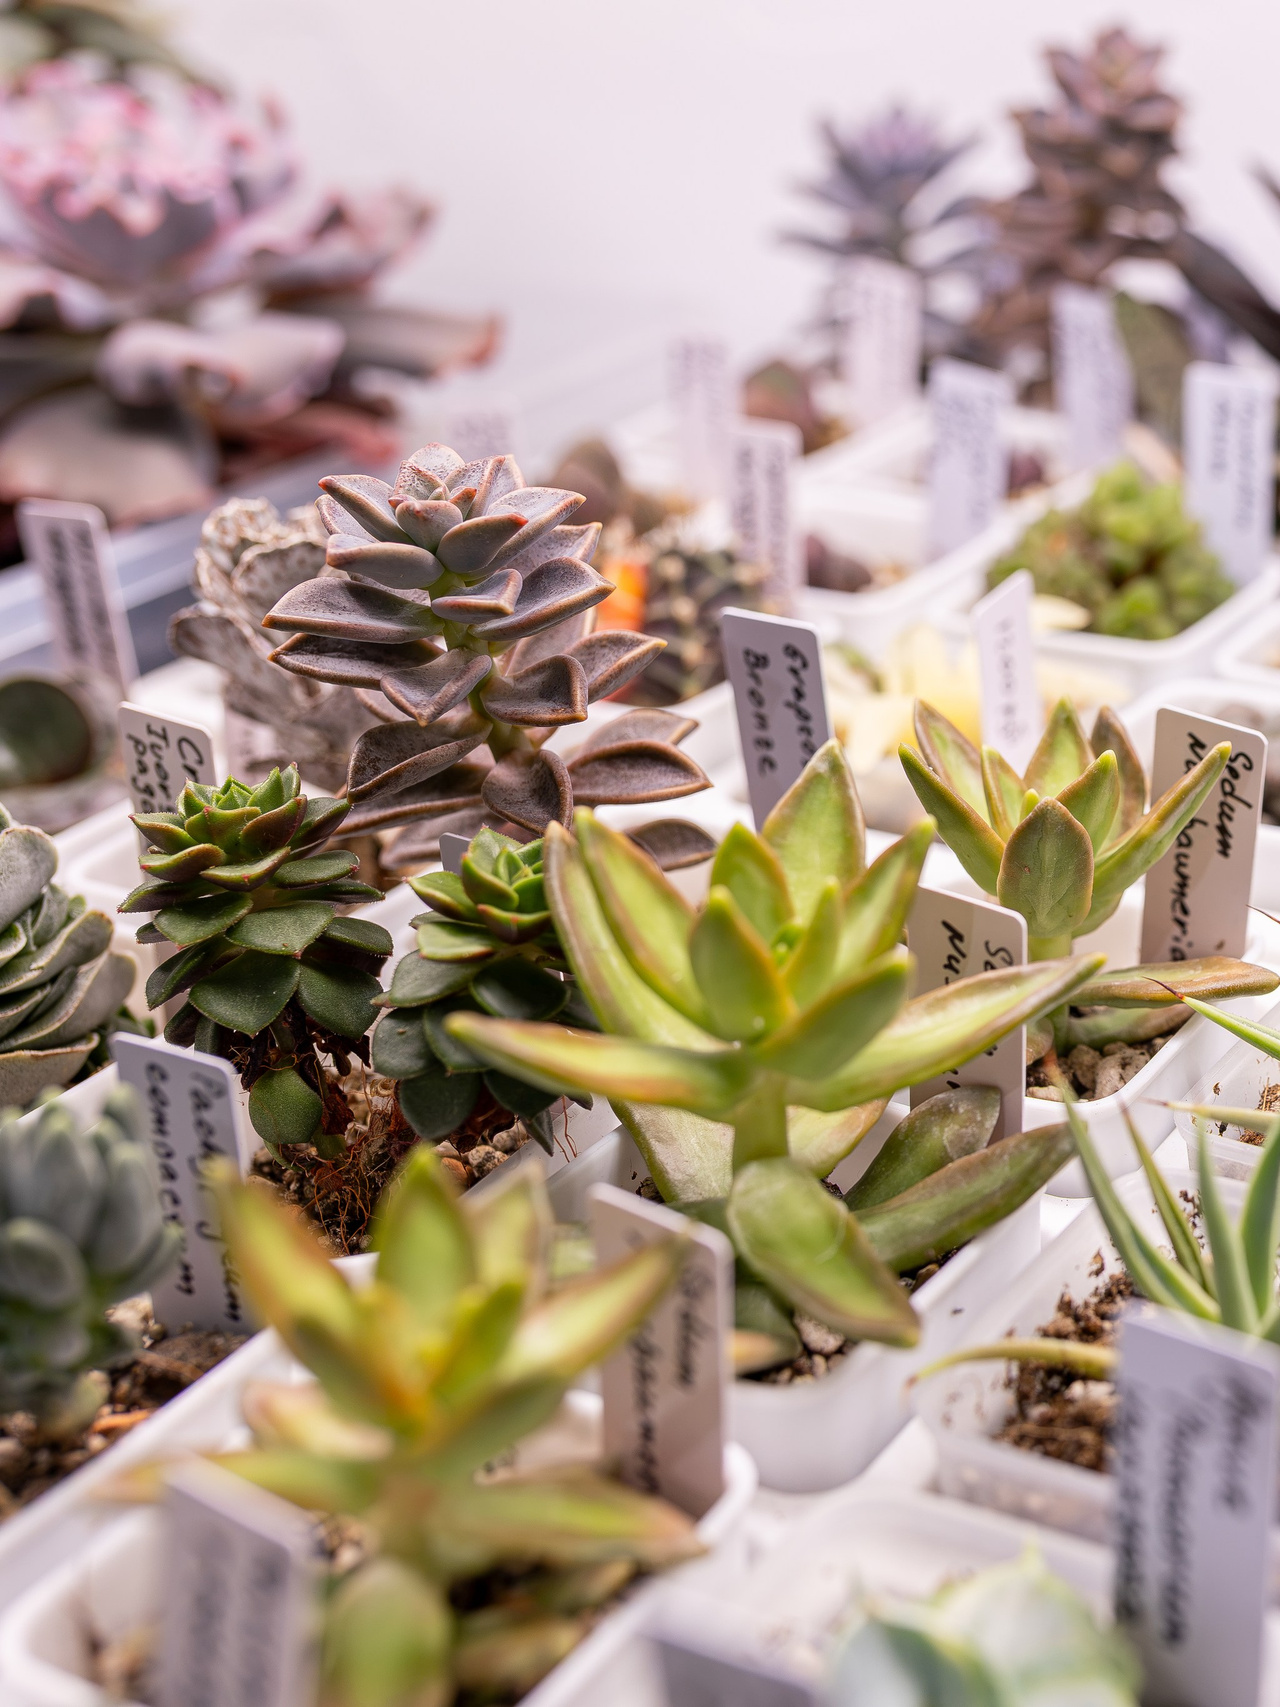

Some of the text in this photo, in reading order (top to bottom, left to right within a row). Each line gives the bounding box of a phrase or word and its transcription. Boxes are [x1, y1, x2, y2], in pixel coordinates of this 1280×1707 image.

[742, 646, 777, 778] Bronze
[782, 641, 817, 769] Grapto
[126, 733, 155, 813] pago
[1214, 751, 1254, 860] Sedum
[1170, 731, 1209, 961] Nubaumeria
[145, 1062, 196, 1296] compactm
